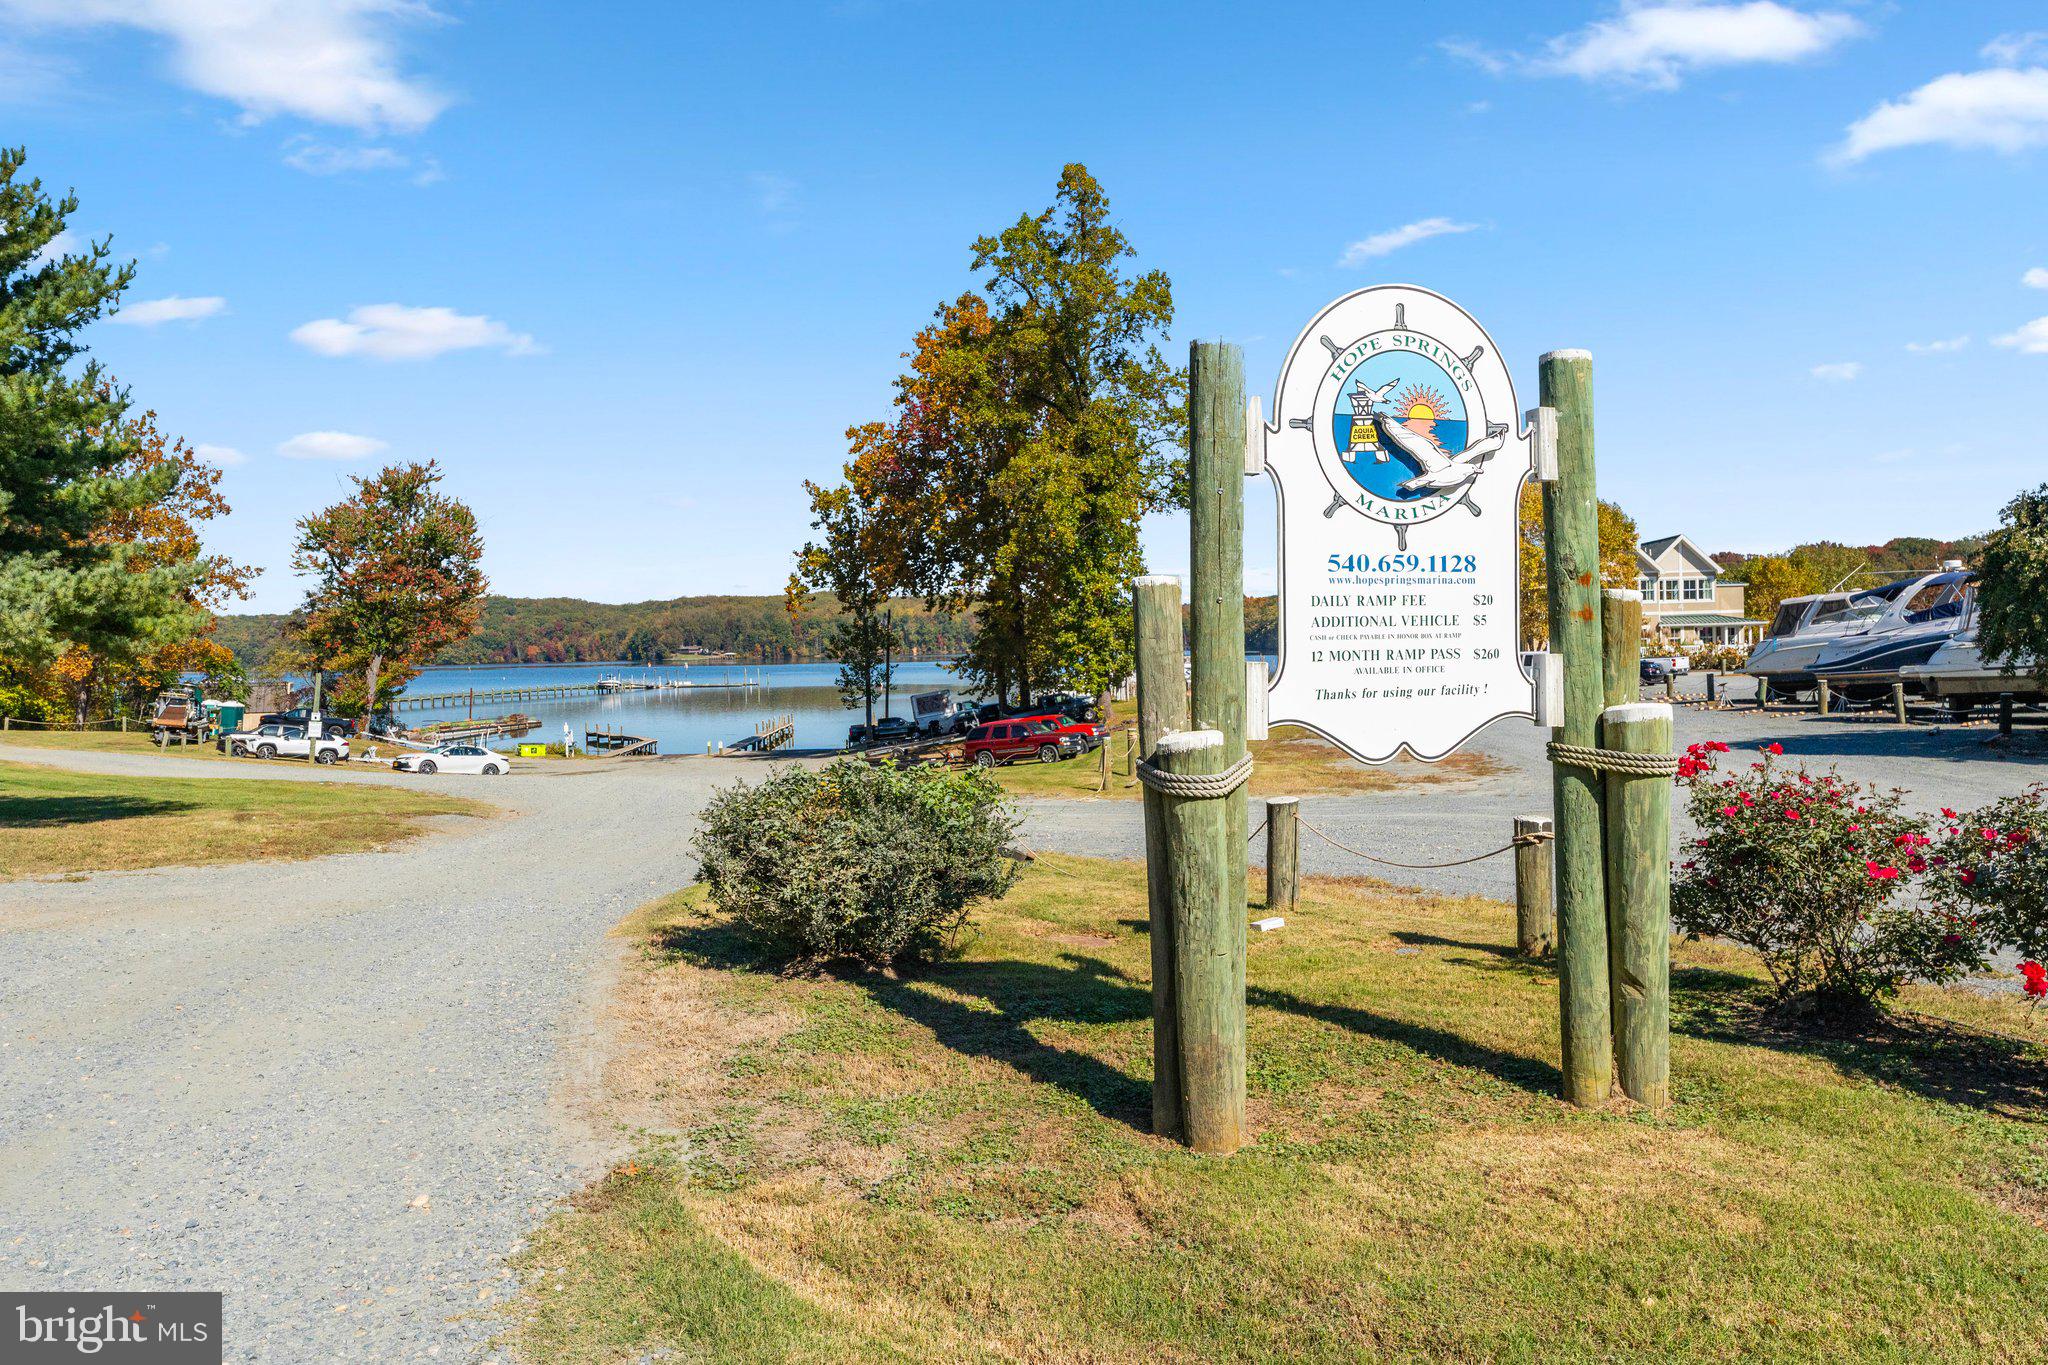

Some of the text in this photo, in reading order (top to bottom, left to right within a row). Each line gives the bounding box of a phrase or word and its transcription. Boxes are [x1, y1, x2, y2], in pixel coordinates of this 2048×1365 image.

[1330, 334, 1473, 393] HOPE SPRINGS
[1354, 492, 1452, 520] MARINA
[1327, 553, 1477, 573] 540.659.1128
[1328, 574, 1476, 587] www.hopespringsmarina.com
[1311, 594, 1493, 607] DAILY RAMP FEE $20
[1311, 614, 1487, 629] ADDITIONAL VEHICLE $5
[1311, 648, 1500, 662] 12 MONTH RAMP PASS $260
[1353, 665, 1446, 675] AVAILABLE IN OFFICE
[1315, 688, 1357, 701] Thanks
[1361, 687, 1378, 699] for
[1382, 686, 1413, 700] using
[1417, 687, 1437, 697] our
